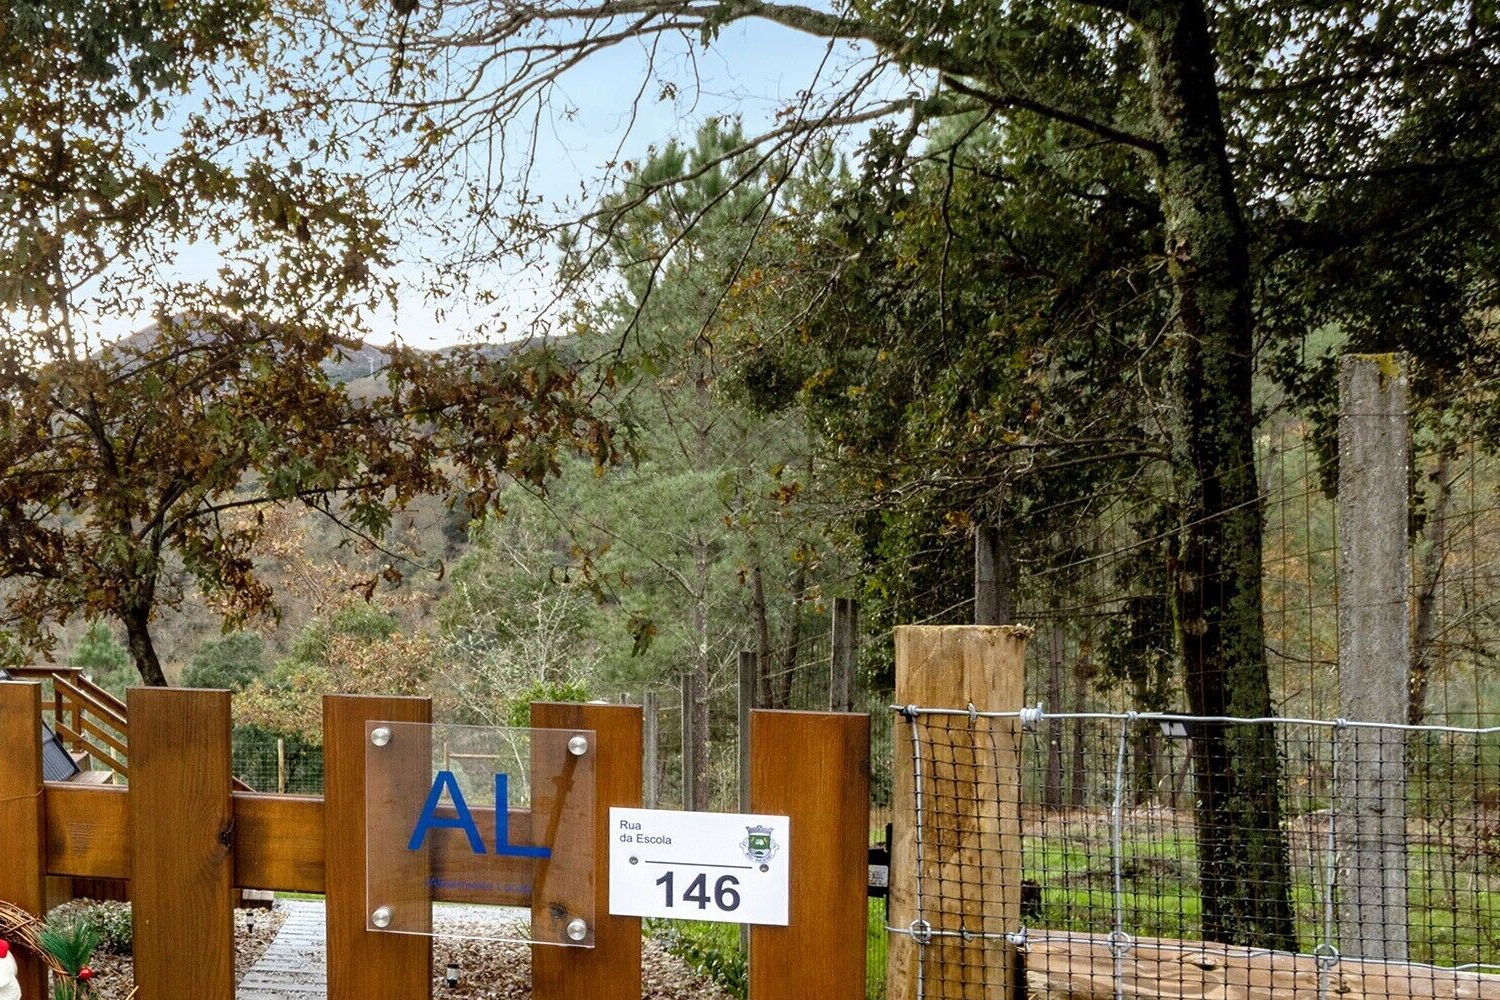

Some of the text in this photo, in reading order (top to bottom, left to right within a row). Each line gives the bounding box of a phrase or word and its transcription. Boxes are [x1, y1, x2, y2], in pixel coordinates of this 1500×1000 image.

[407, 770, 551, 858] AL
[619, 819, 642, 831] Rua
[619, 833, 672, 845] da Escola
[655, 871, 741, 912] 146
